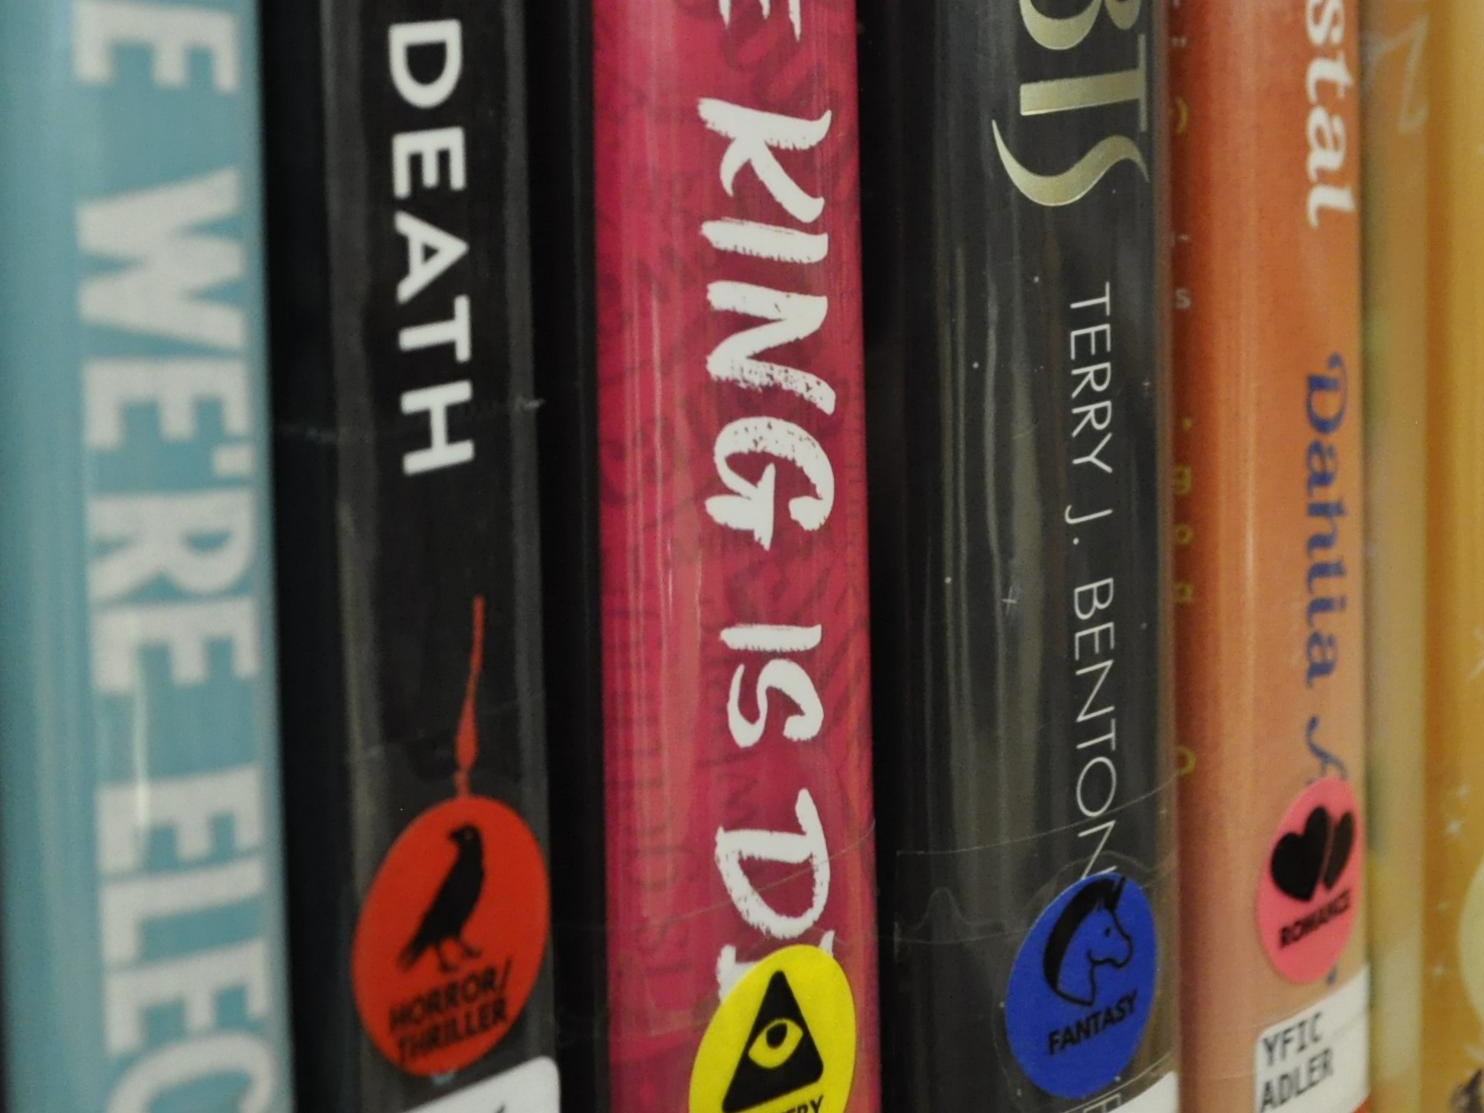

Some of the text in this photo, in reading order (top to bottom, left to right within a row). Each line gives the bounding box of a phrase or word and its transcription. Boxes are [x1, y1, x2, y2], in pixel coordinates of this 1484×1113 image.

[389, 19, 475, 477] DEATH
[697, 95, 836, 551] KING
[76, 165, 260, 696] WE'RE
[1306, 352, 1348, 689] Dahlia
[719, 622, 824, 749] IS
[1063, 282, 1119, 882] TERRY J. BENTON
[1047, 990, 1139, 1056] FANTASY
[1278, 888, 1351, 949] ROMANCE
[1258, 1047, 1335, 1113] ADLER
[1262, 1011, 1323, 1068] YFIC
